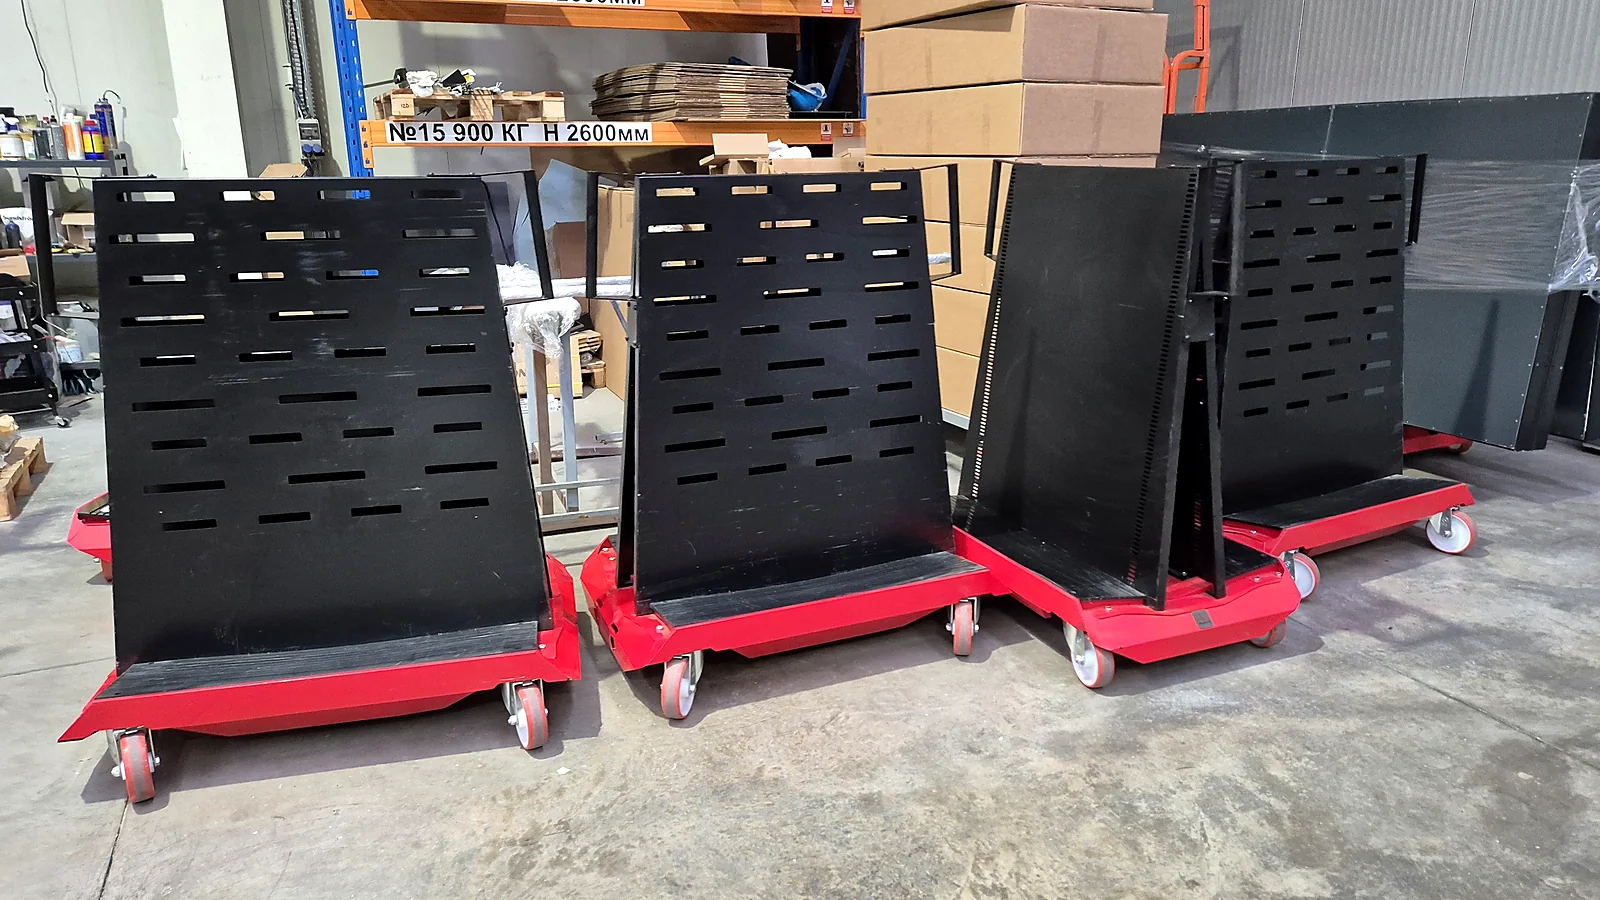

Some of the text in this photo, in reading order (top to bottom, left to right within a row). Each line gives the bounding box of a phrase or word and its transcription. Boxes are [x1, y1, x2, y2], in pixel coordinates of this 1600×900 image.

[389, 122, 446, 142] №15
[452, 122, 494, 142] 900
[501, 123, 530, 142] КГ
